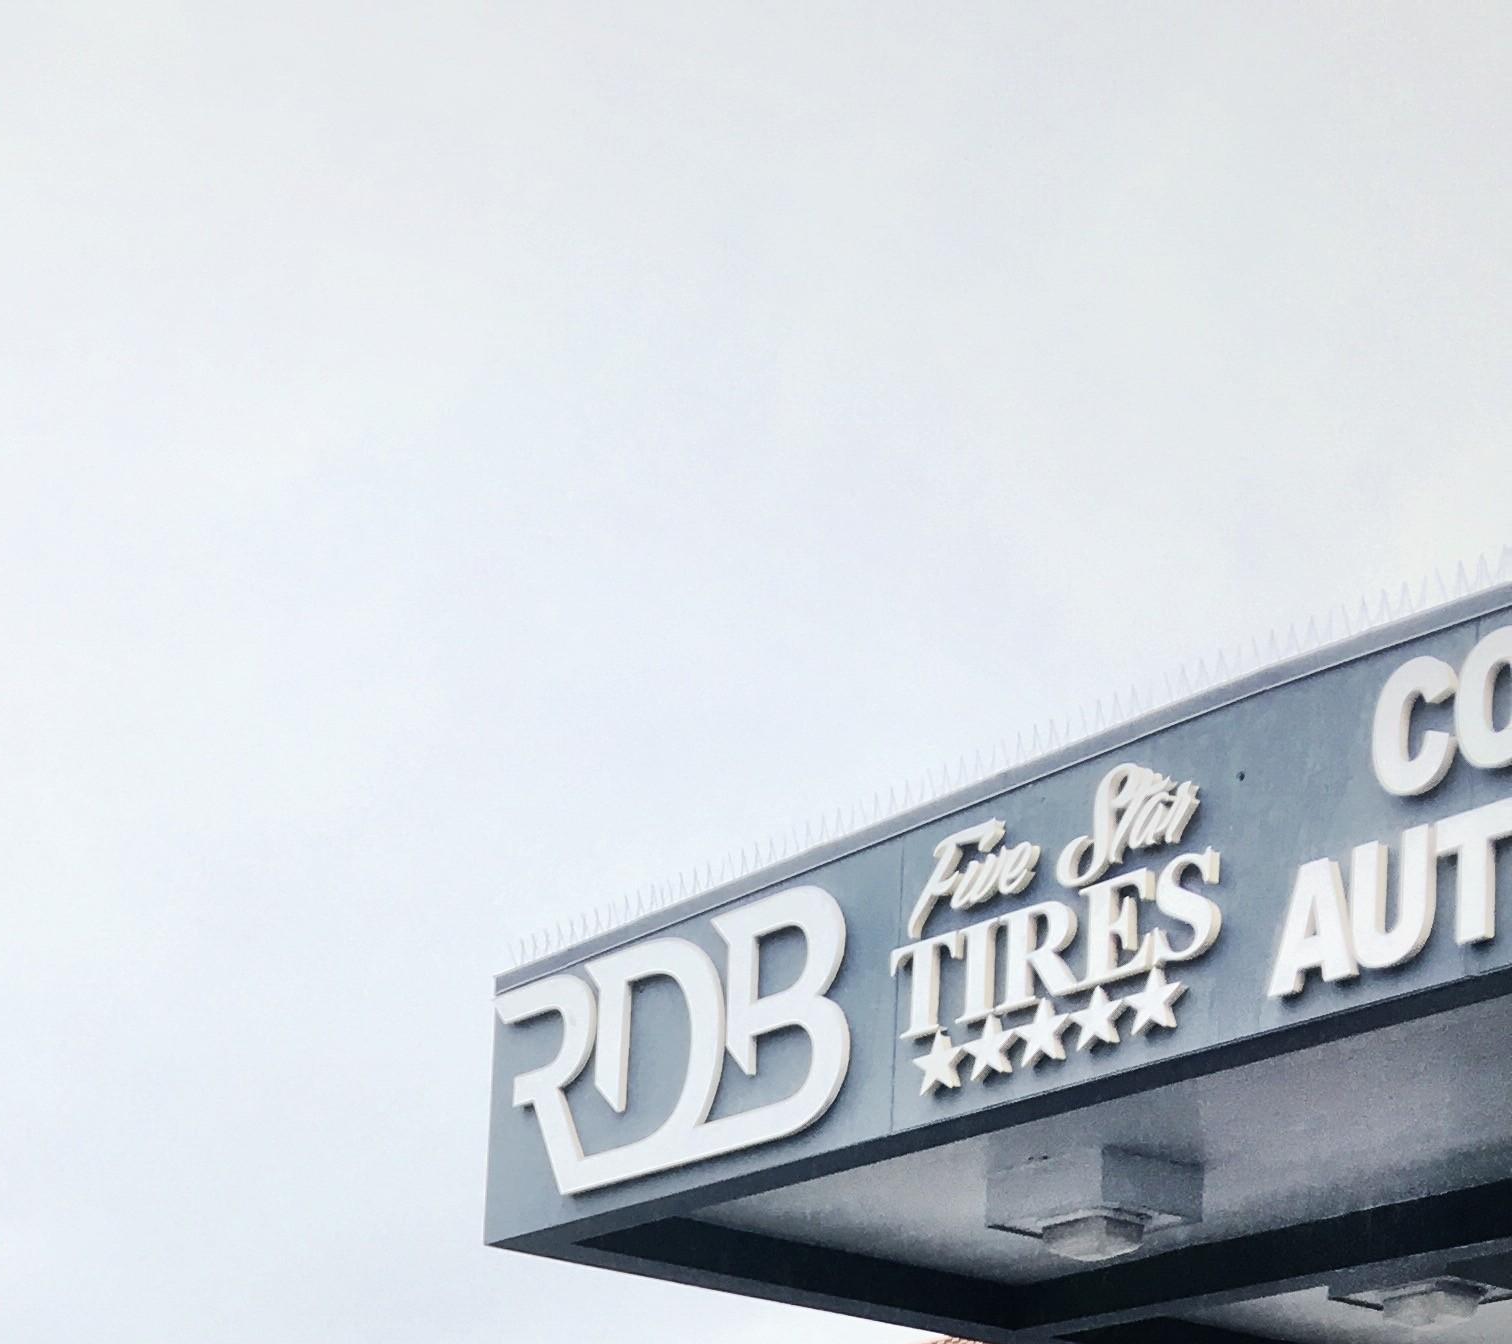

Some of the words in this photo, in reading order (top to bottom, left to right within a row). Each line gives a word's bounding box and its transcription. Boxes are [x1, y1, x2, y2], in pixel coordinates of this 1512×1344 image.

[890, 846, 1223, 1040] TIRES
[908, 817, 1040, 939] Five
[1056, 763, 1201, 888] Star
[1268, 798, 1512, 998] AUT
[494, 885, 852, 1196] RDB
